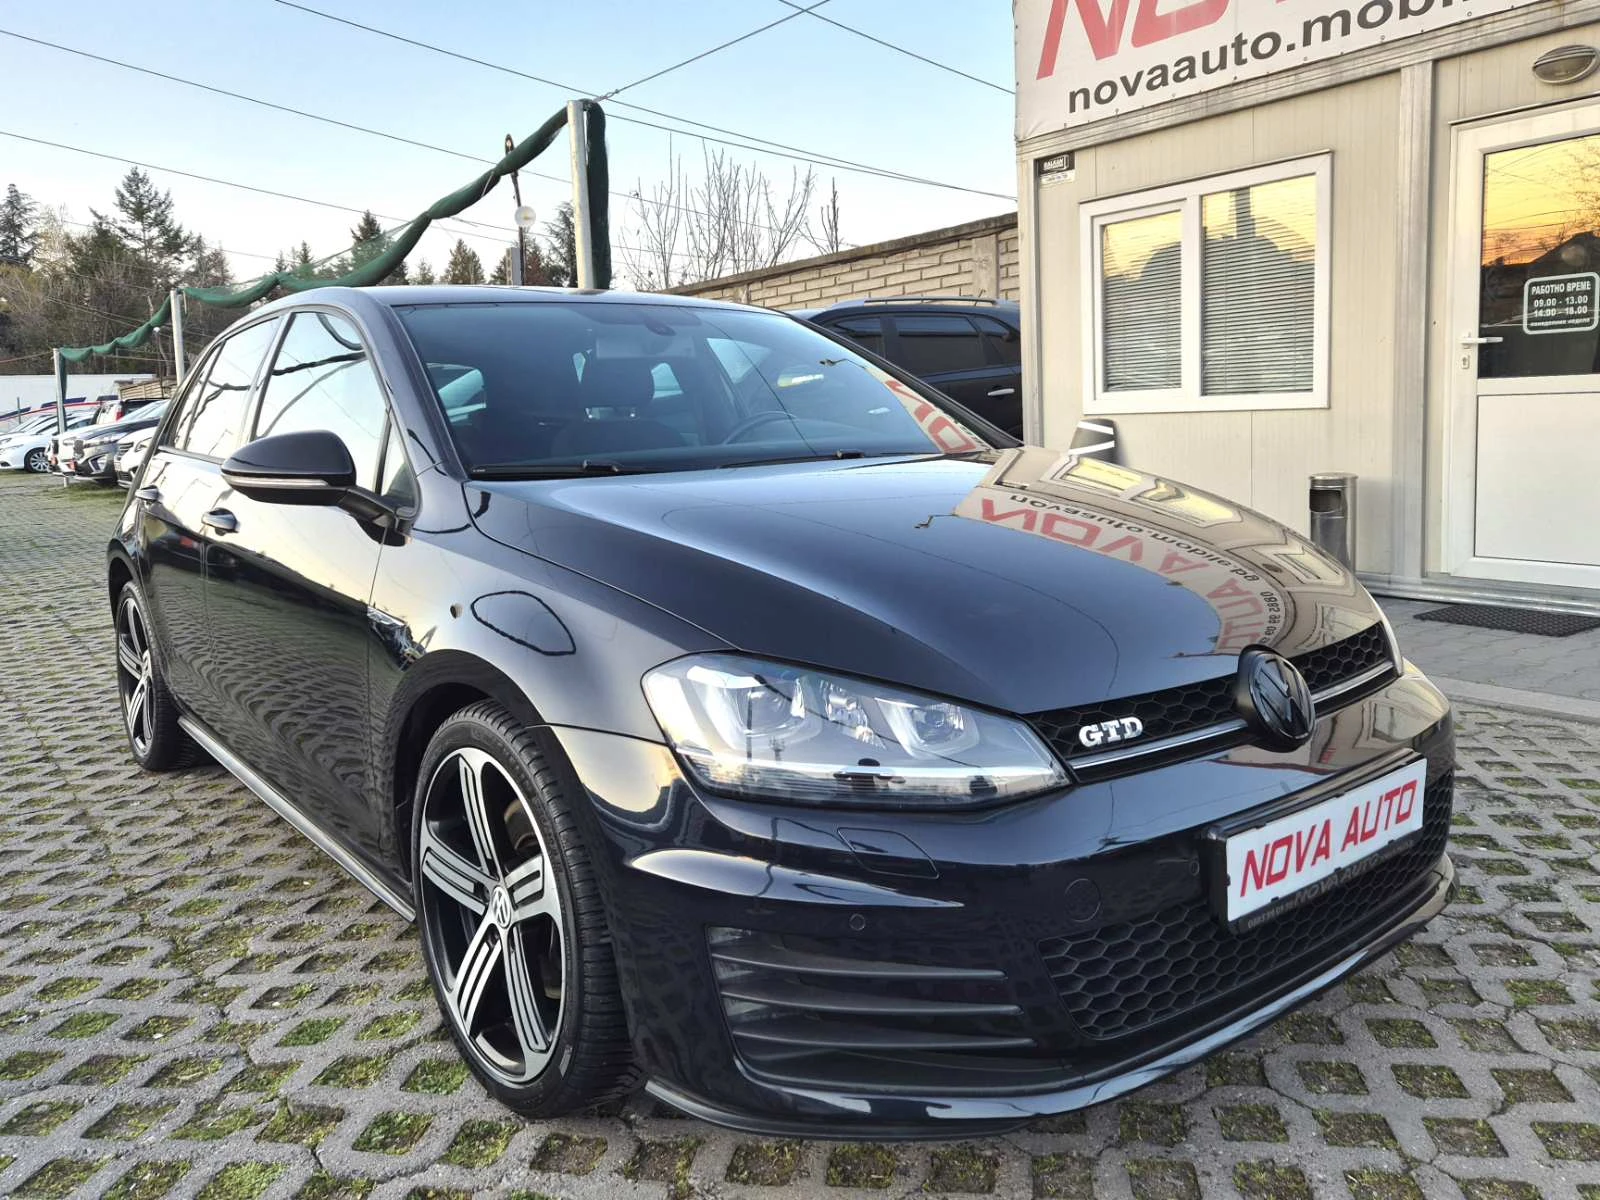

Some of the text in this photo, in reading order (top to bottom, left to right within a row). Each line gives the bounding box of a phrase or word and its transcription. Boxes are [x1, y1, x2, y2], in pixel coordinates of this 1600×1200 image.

[1531, 281, 1591, 295] РАБОТНО ВРЕМЕ
[1533, 298, 1557, 308] 09.00
[1565, 295, 1588, 305] 13.00
[1078, 716, 1143, 747] GTD
[1240, 779, 1418, 898] NOVA AUTO
